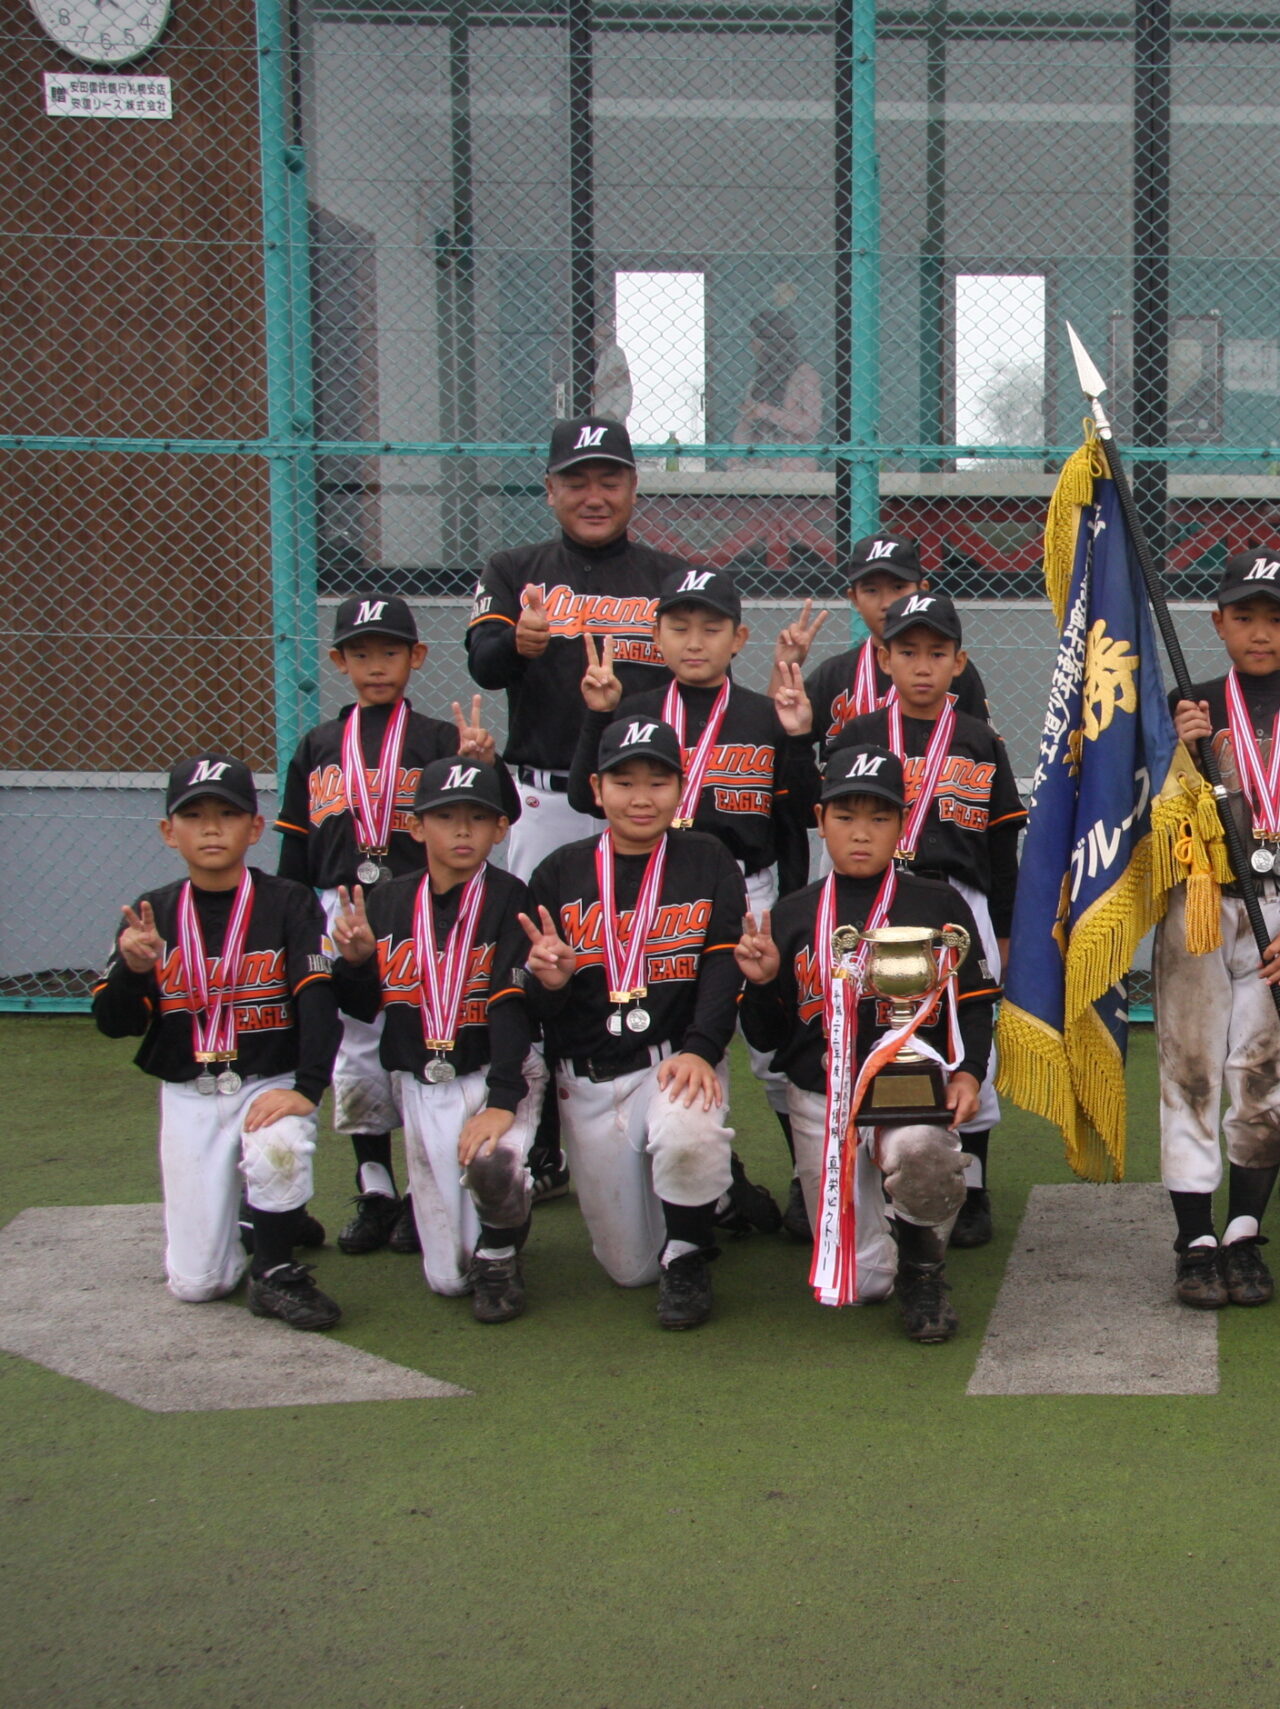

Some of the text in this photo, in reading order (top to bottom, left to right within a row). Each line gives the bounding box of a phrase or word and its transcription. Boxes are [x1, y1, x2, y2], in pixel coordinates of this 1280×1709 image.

[59, 8, 70, 25] 8
[139, 14, 151, 29] 4
[78, 26, 89, 41] 7
[101, 32, 112, 50] 6
[124, 28, 135, 45] 5
[574, 426, 608, 450] M
[866, 540, 898, 561] M
[677, 570, 716, 593] M
[354, 600, 388, 626] M
[901, 595, 936, 617] M
[609, 640, 667, 667] EAGLE
[618, 721, 658, 747] M
[188, 760, 231, 786] M
[441, 764, 481, 790] M
[845, 753, 887, 779] M
[714, 788, 773, 816] EAGLE
[939, 798, 989, 832] EGLES
[647, 953, 700, 984] EAGL
[822, 1155, 840, 1272] 真栄ビクトリー
